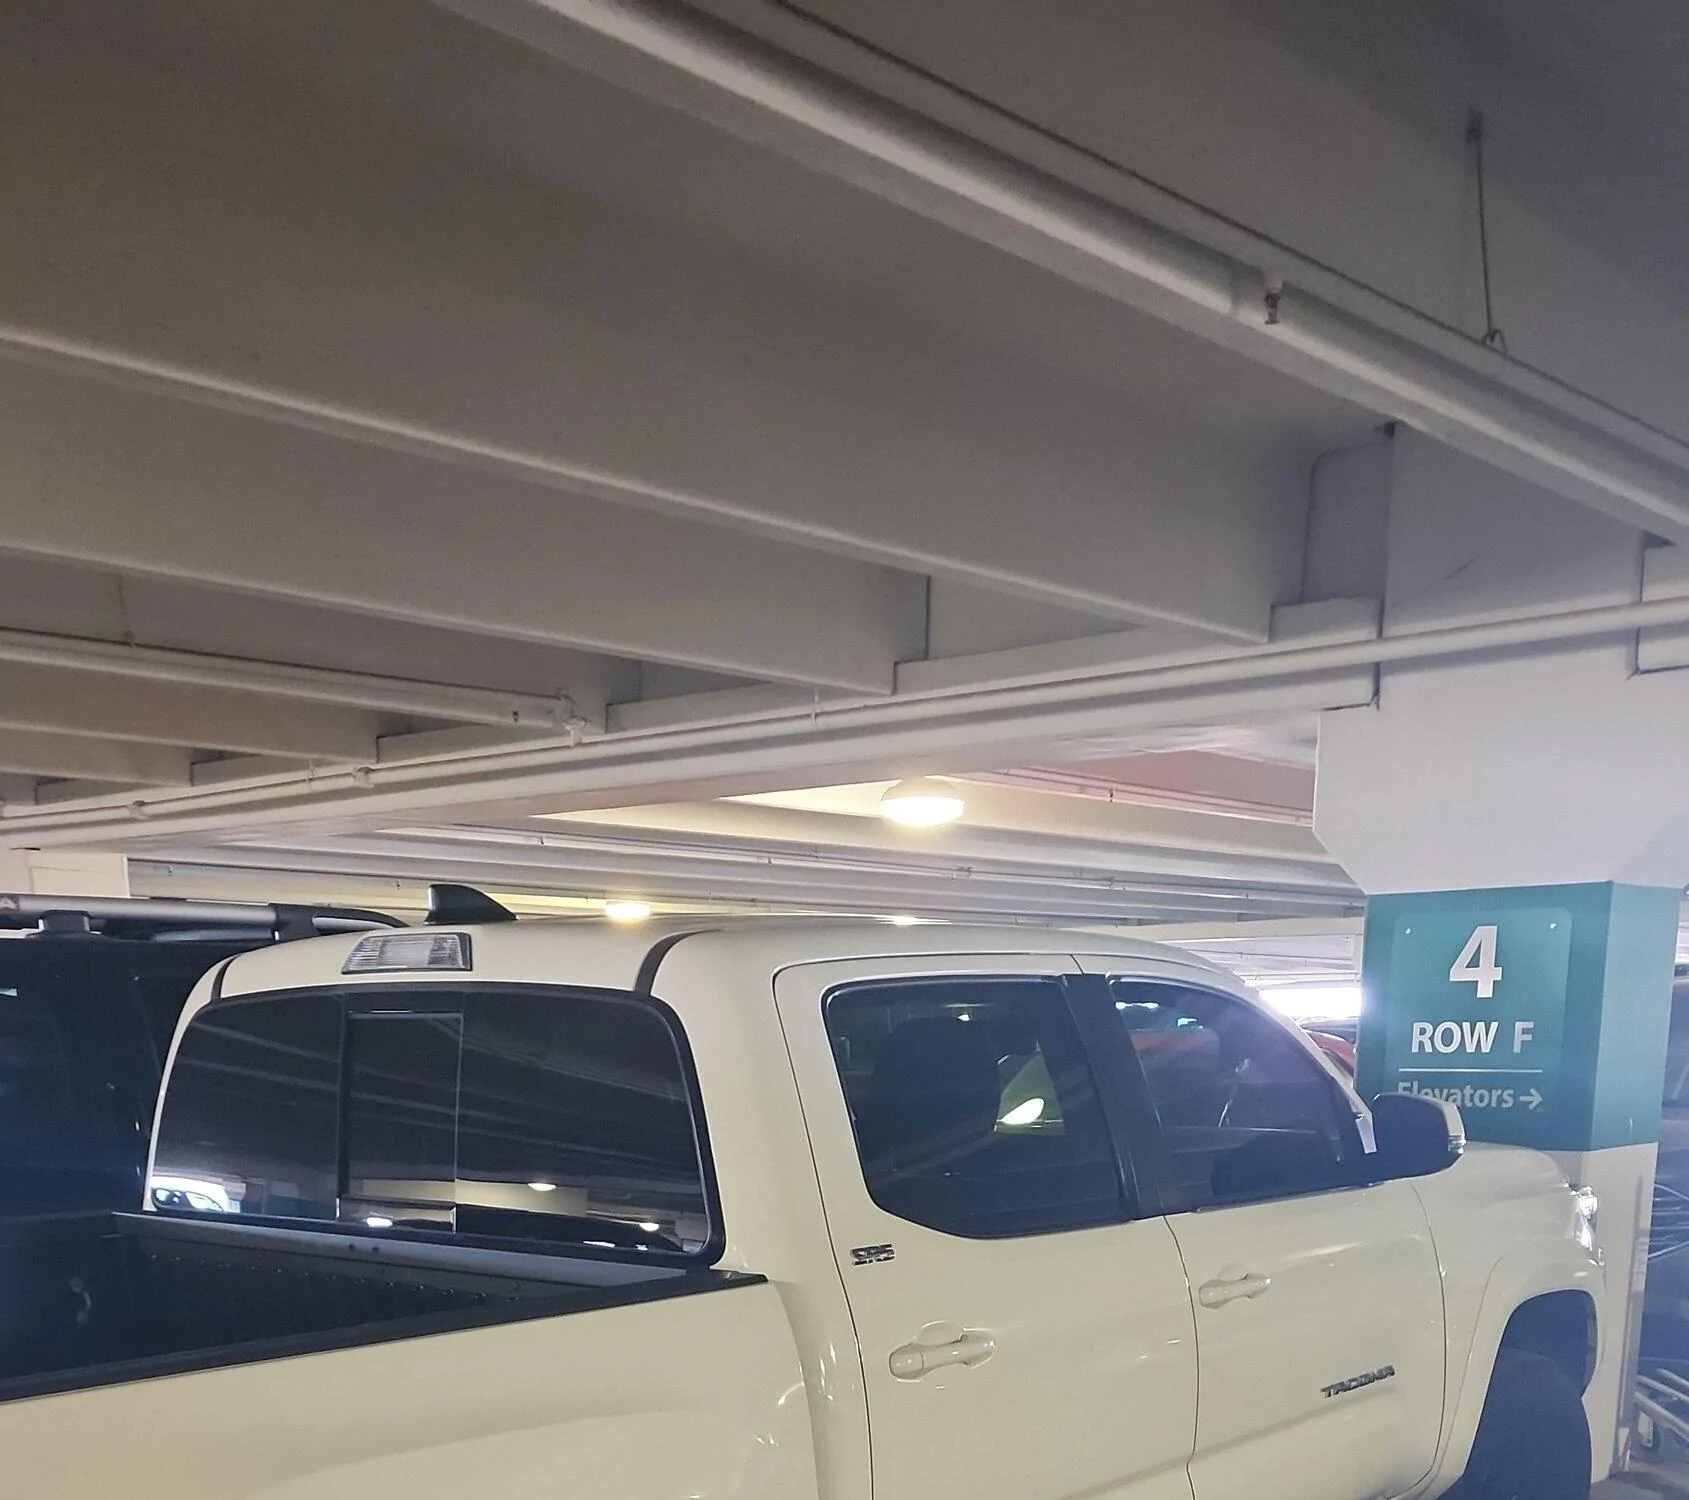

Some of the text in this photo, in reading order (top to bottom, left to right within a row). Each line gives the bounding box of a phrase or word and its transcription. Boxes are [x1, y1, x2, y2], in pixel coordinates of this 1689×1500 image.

[1450, 925, 1502, 998] 4
[1412, 1021, 1535, 1053] ROW F
